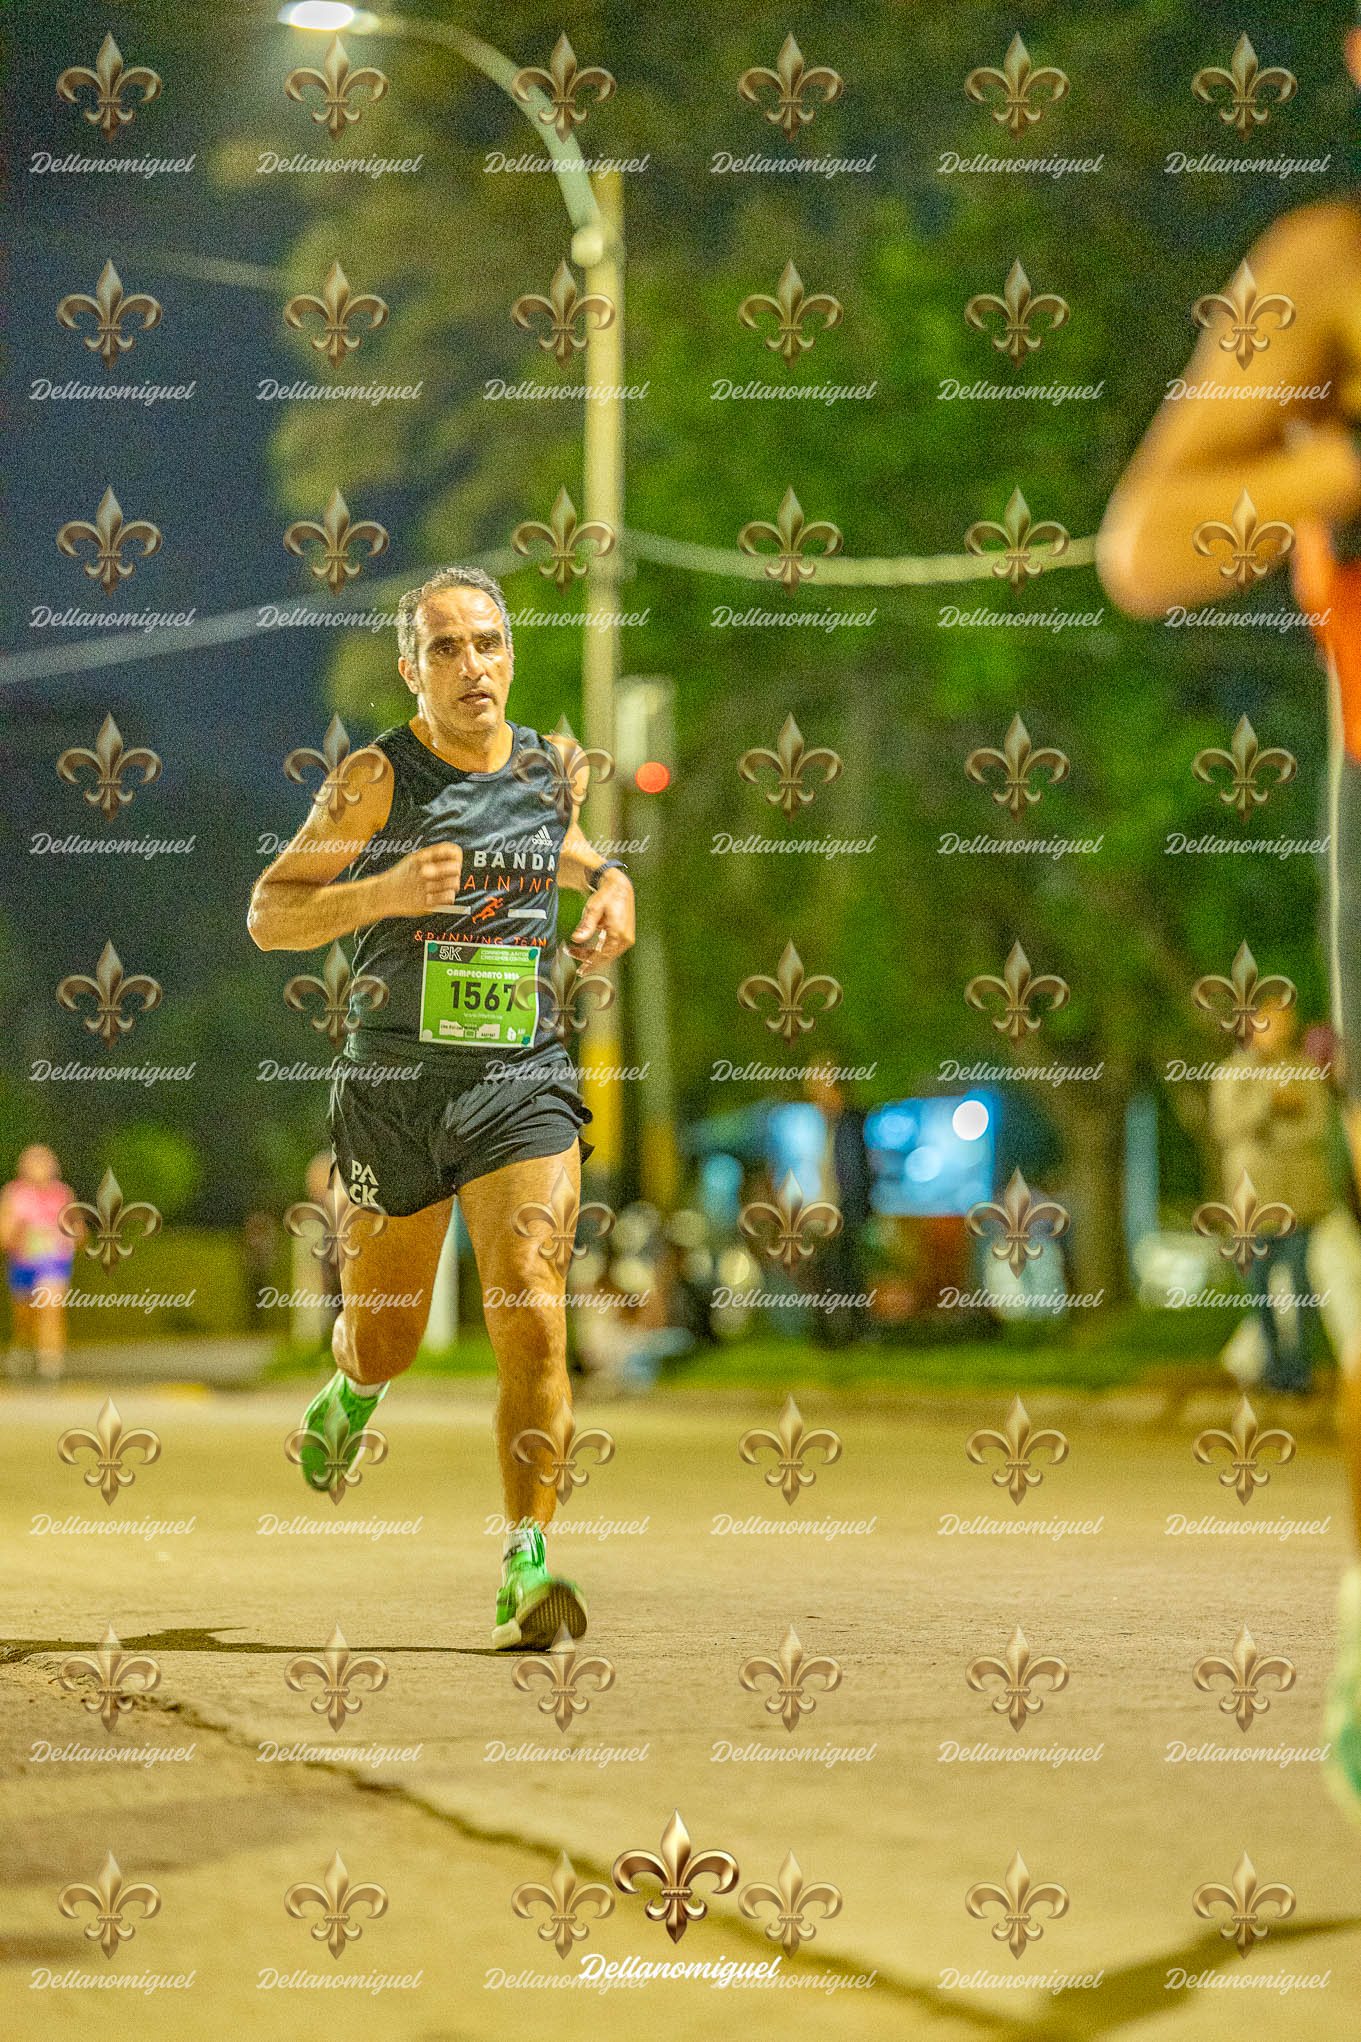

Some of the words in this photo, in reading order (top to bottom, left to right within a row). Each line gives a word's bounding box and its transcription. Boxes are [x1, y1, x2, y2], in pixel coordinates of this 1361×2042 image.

[474, 851, 555, 871] BANDA
[439, 945, 463, 962] 5K
[450, 980, 518, 1012] 1567
